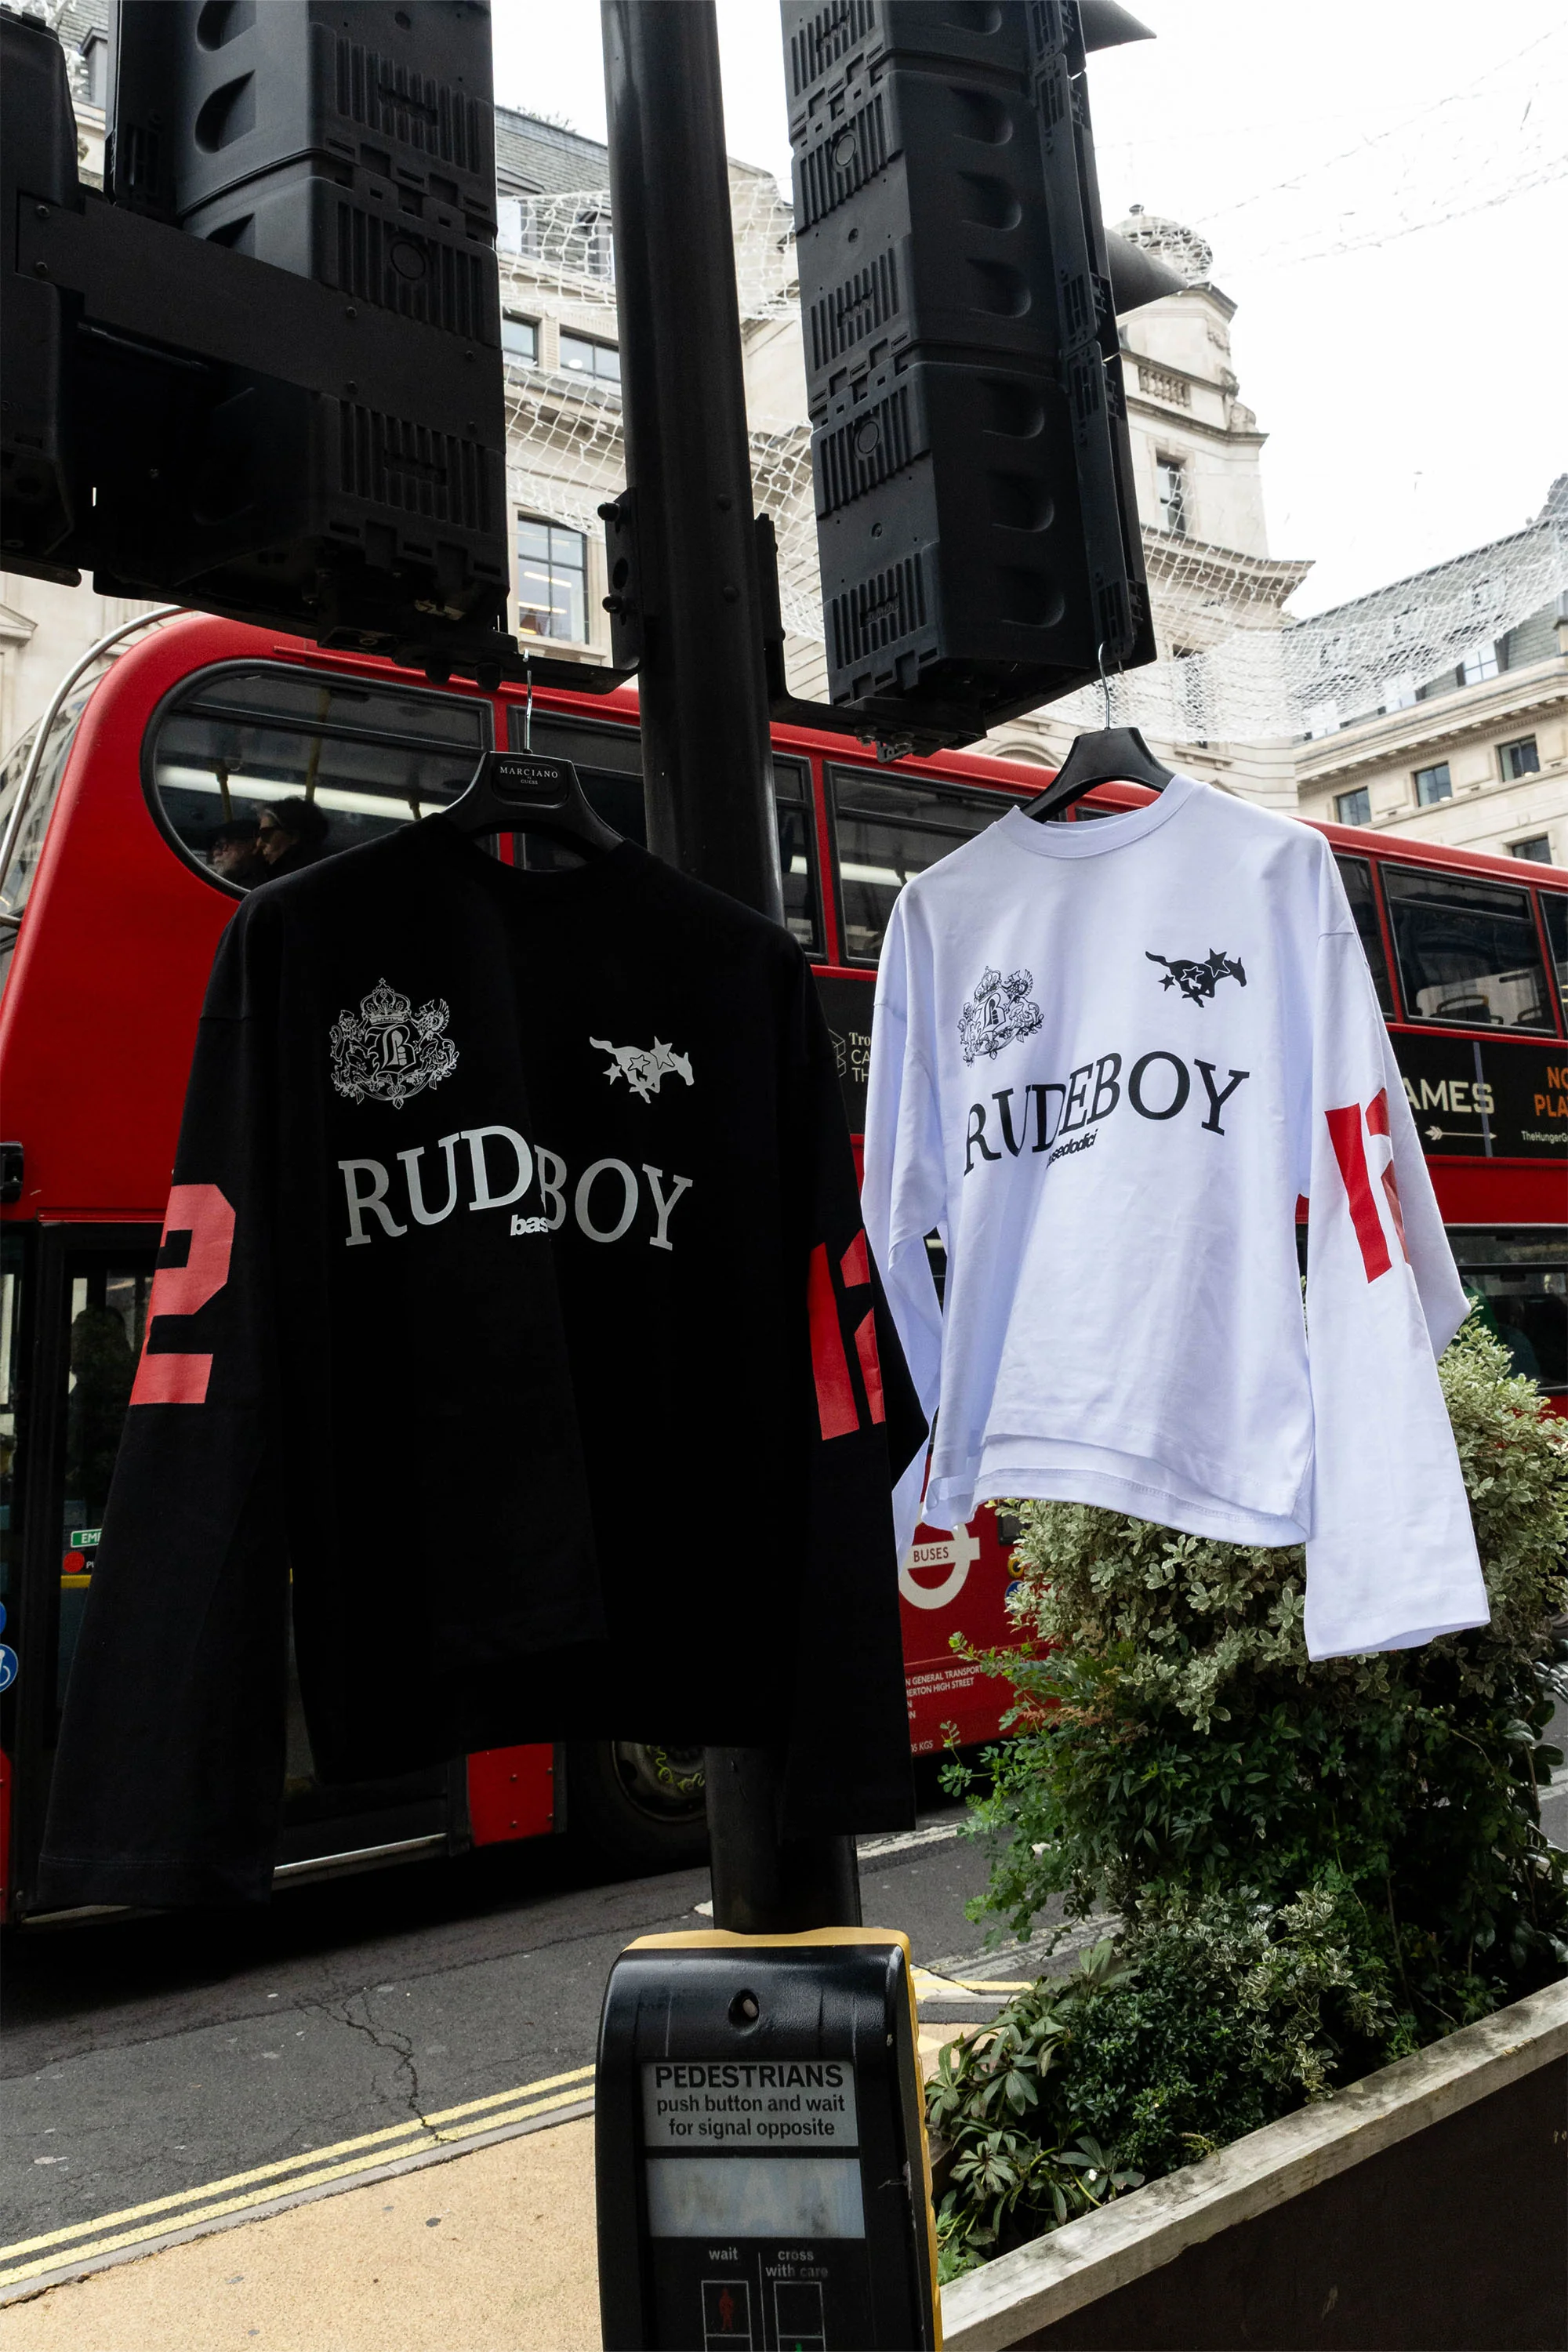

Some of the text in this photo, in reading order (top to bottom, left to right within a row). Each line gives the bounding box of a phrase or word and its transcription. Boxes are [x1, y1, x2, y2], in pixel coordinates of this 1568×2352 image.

[499, 766, 558, 778] MARCIANO
[964, 1051, 1250, 1177] RUDEBOY
[1521, 1130, 1568, 1145] TheHungerG
[913, 1546, 949, 1563] BUSES
[912, 1673, 943, 1685] GENERAL
[945, 1665, 982, 1679] TRANSPORT
[933, 1682, 950, 1693] HIGH
[951, 1677, 975, 1690] STREET
[919, 1740, 933, 1751] KGS
[655, 2064, 844, 2088] PEDESTRIANS
[657, 2094, 846, 2116] push button and wait
[669, 2118, 835, 2140] for signal opposite
[709, 2247, 815, 2261] wait cross
[765, 2264, 829, 2278] with care
